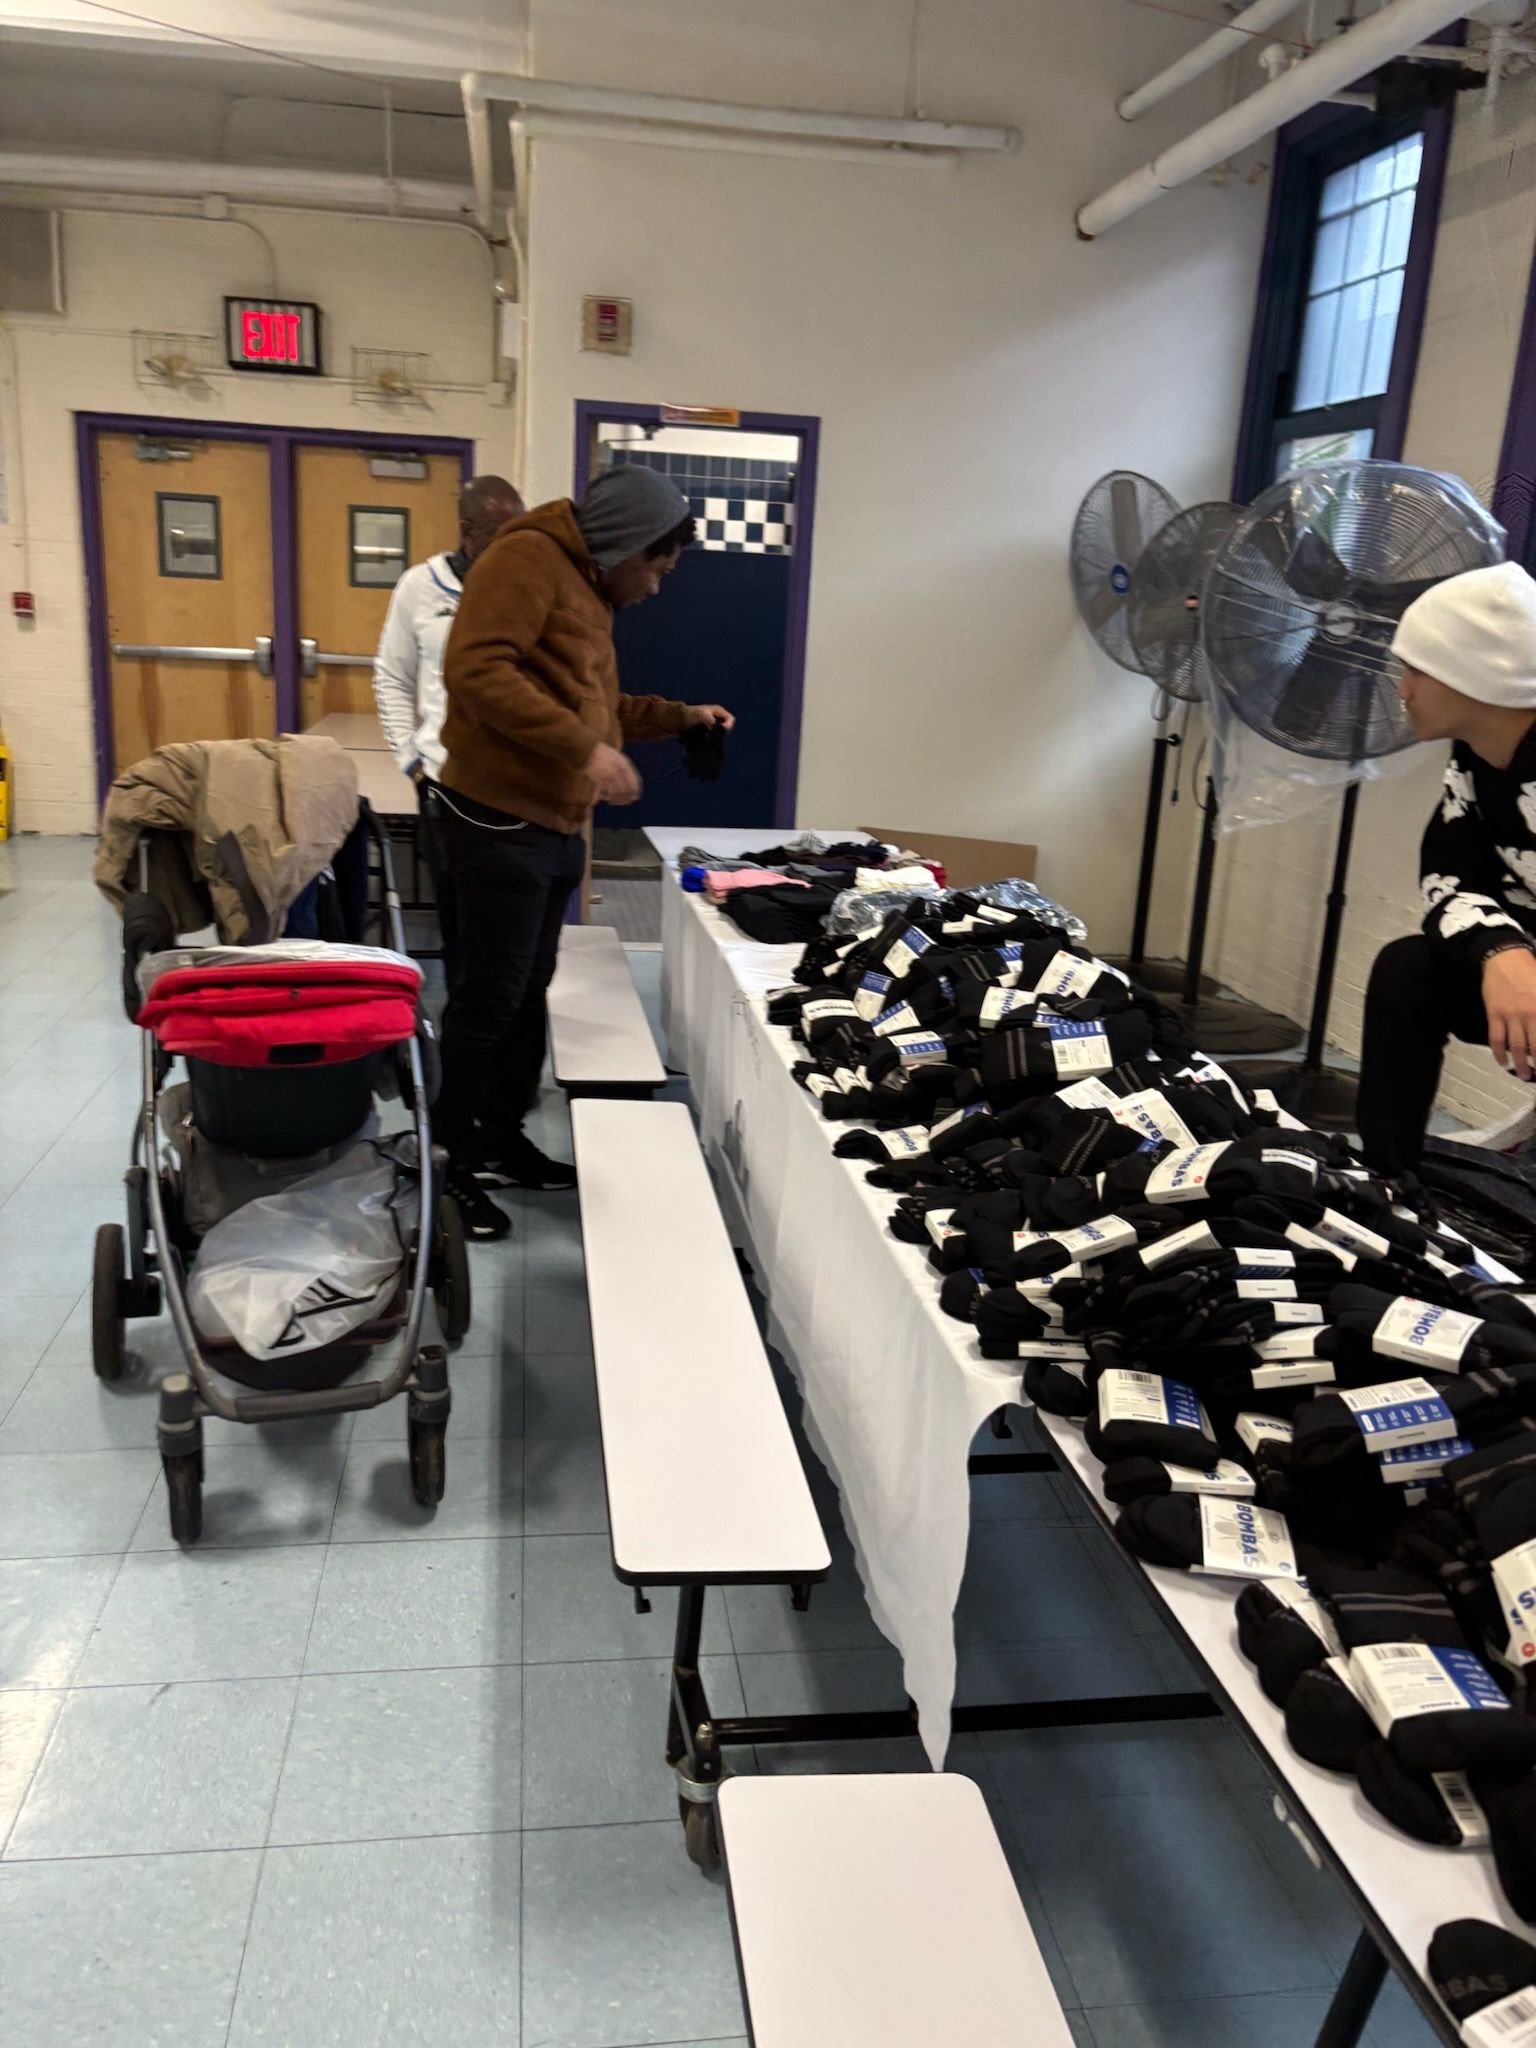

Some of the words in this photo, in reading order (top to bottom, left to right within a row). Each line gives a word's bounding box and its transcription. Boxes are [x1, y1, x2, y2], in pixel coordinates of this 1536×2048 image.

[242, 311, 301, 362] EXIT
[1136, 1112, 1163, 1140] BAS
[1236, 1504, 1260, 1568] BOMBAS
